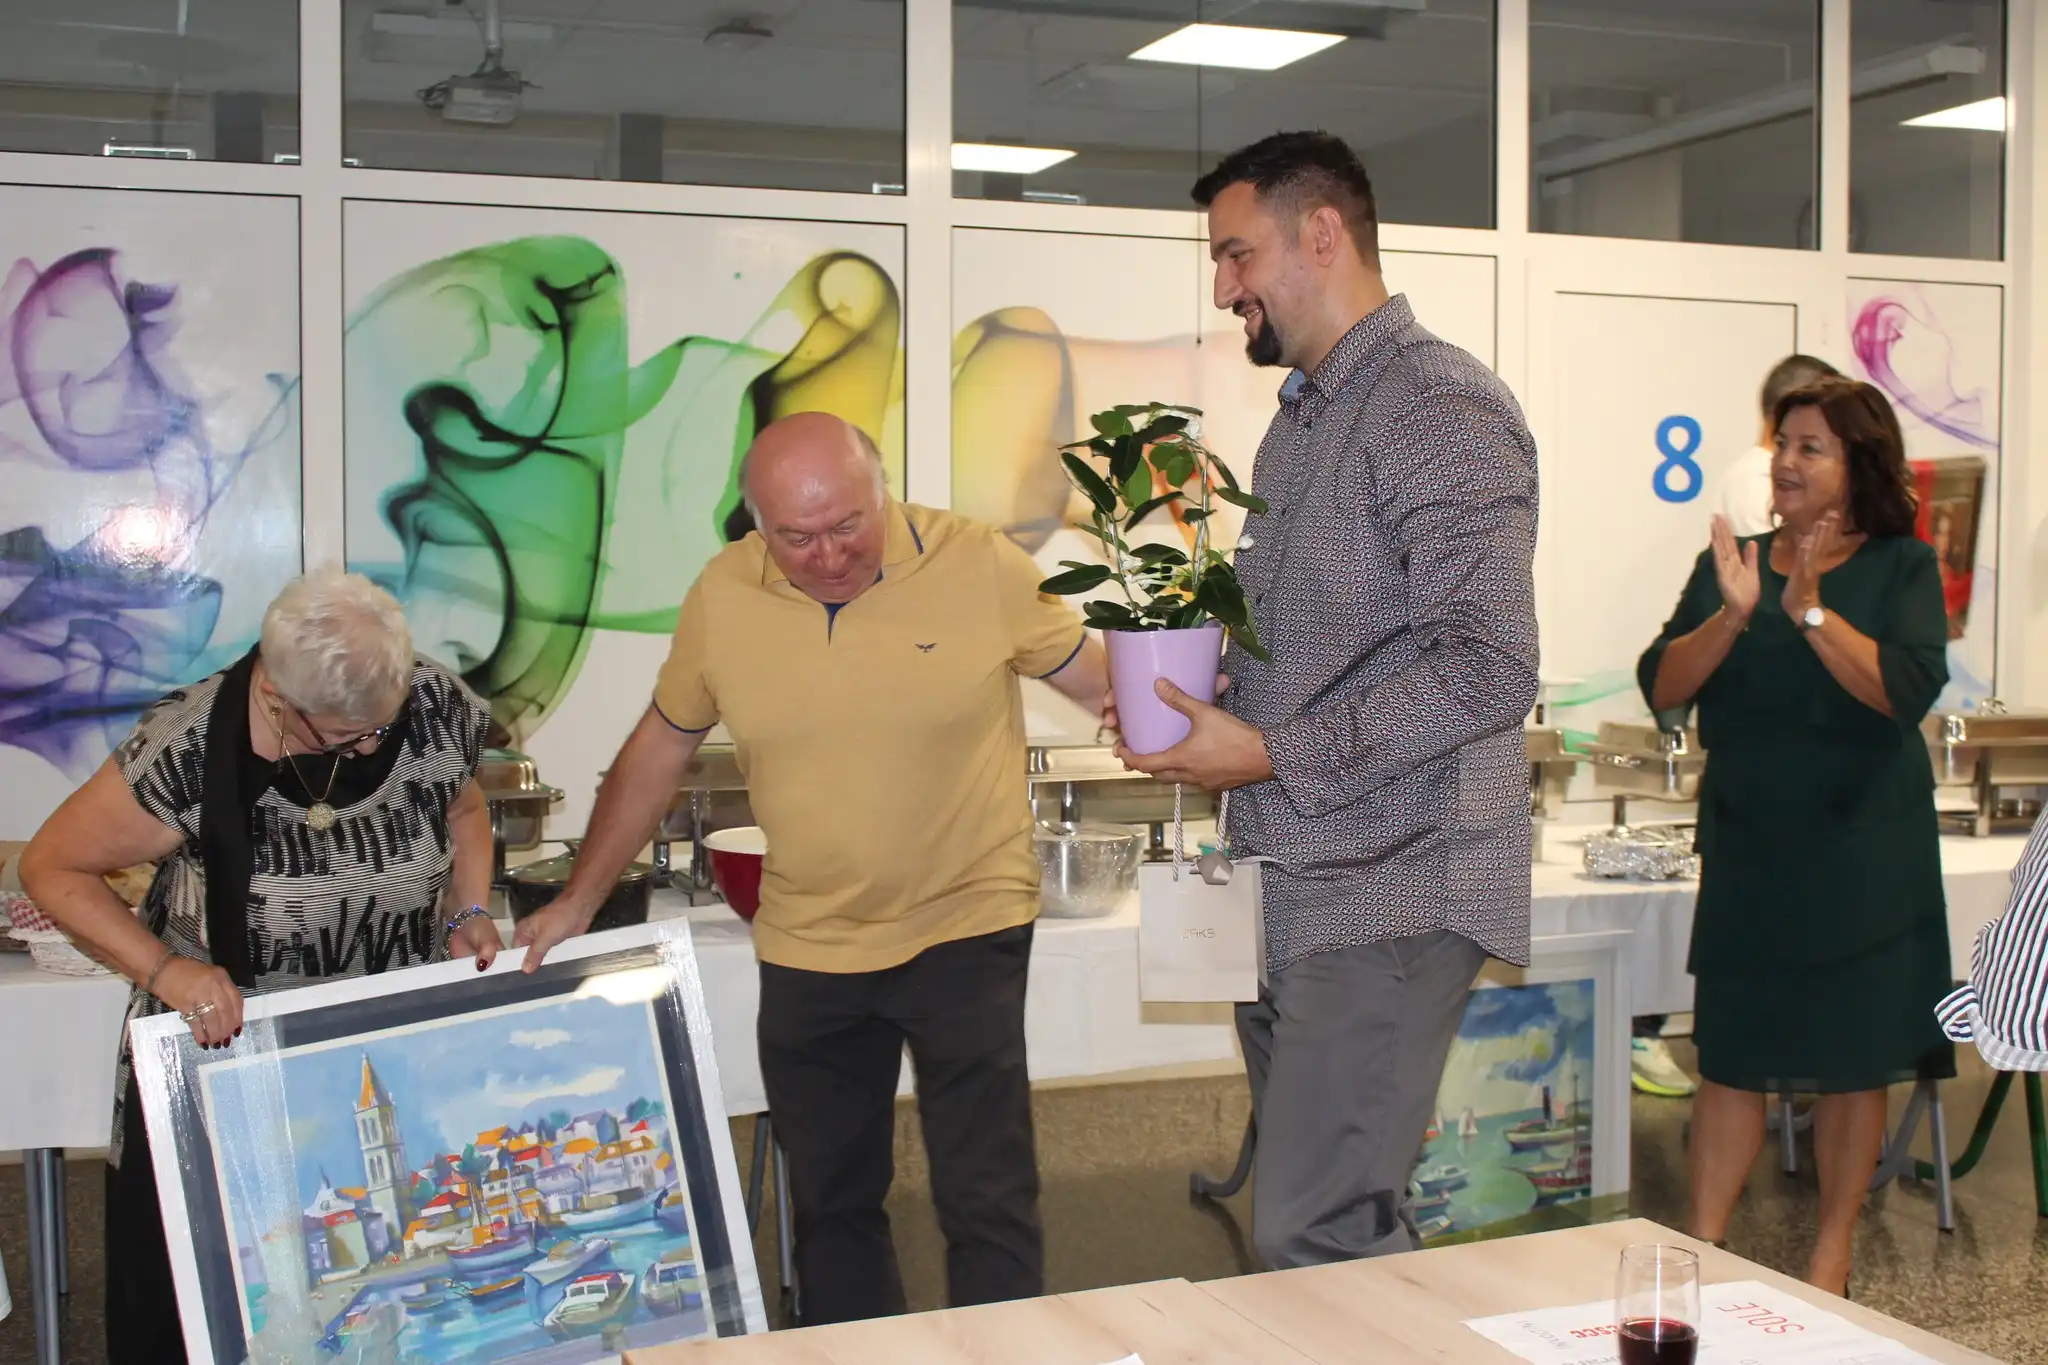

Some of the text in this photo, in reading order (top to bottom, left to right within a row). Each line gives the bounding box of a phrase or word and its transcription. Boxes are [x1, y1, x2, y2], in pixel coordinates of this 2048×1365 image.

[1652, 414, 1704, 503] 8
[1180, 928, 1216, 939] ZAKS
[1716, 1301, 1805, 1335] SOLE
